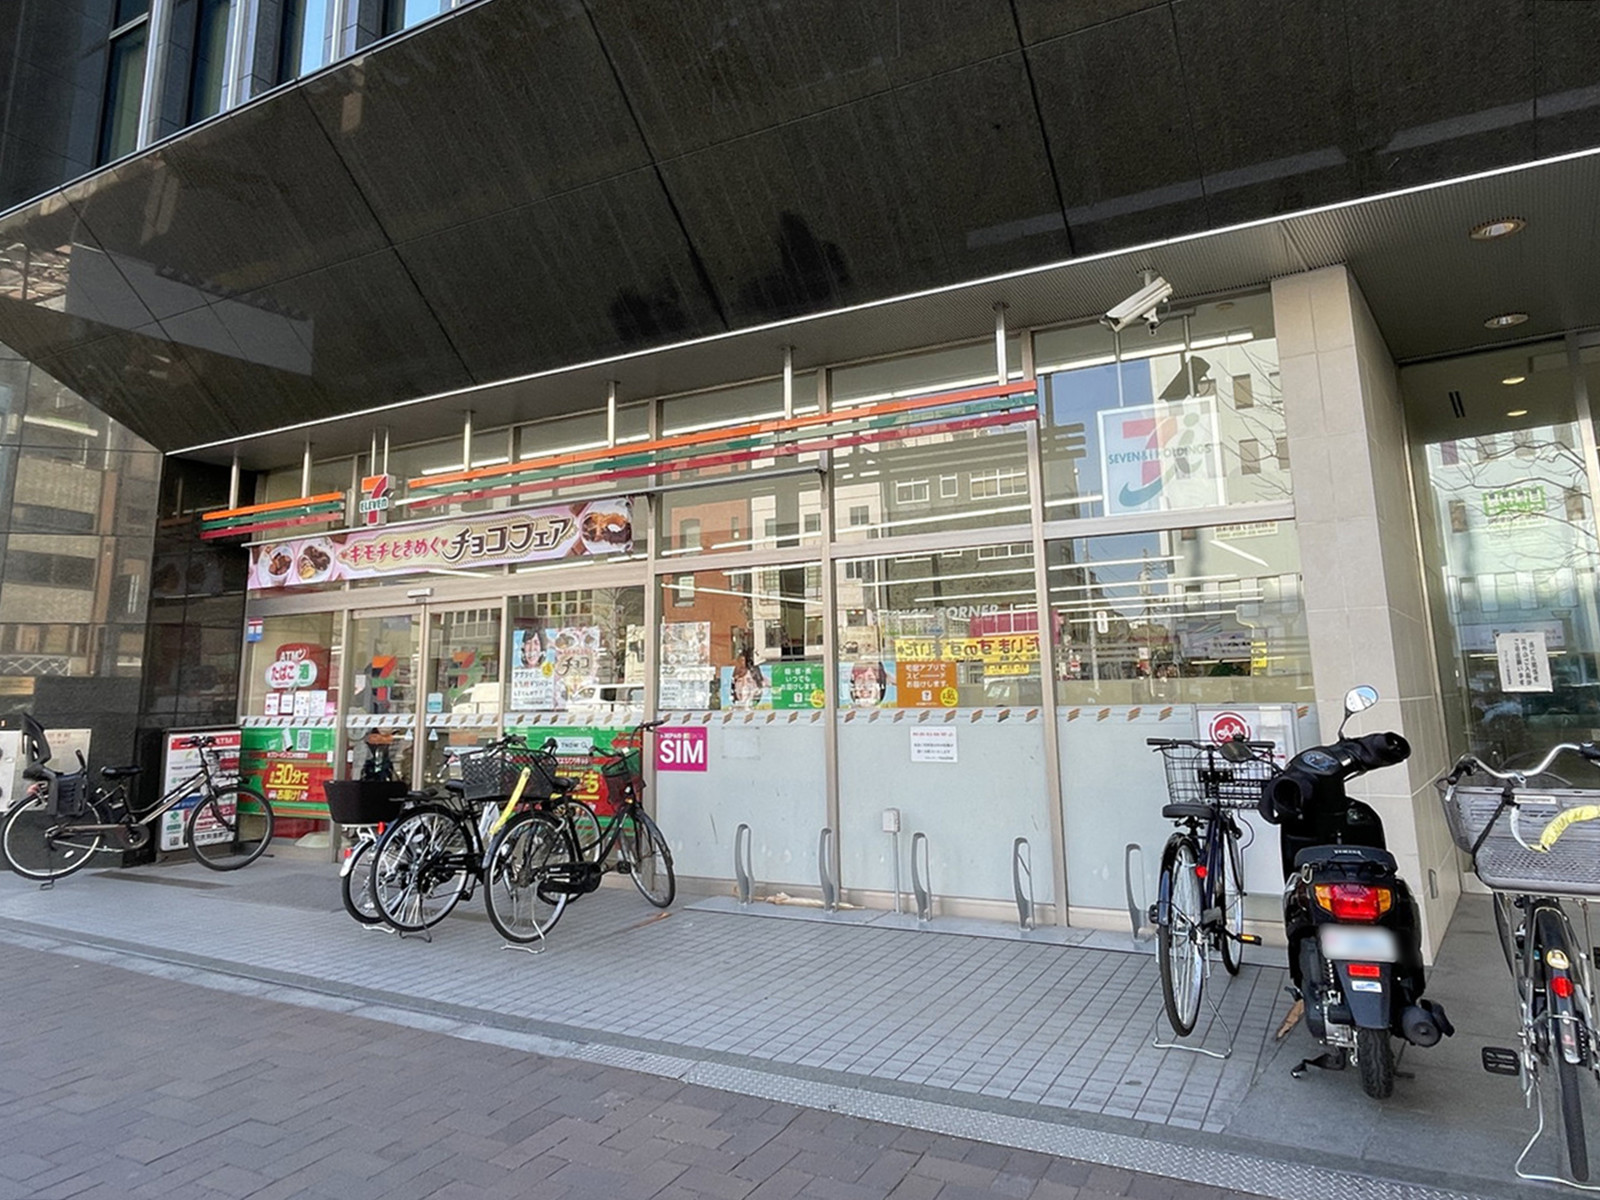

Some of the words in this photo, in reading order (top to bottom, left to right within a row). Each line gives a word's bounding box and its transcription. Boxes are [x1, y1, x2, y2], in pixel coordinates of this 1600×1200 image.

[350, 540, 440, 564] キモチときめく
[441, 517, 573, 563] チョコフェア
[936, 604, 999, 620] CORNER
[271, 664, 295, 682] たばこ
[298, 663, 310, 680] 酒
[556, 655, 590, 676] チョコ
[905, 664, 946, 672] 宅配アプリで
[785, 675, 811, 683] いつでも
[660, 739, 704, 764] SIM
